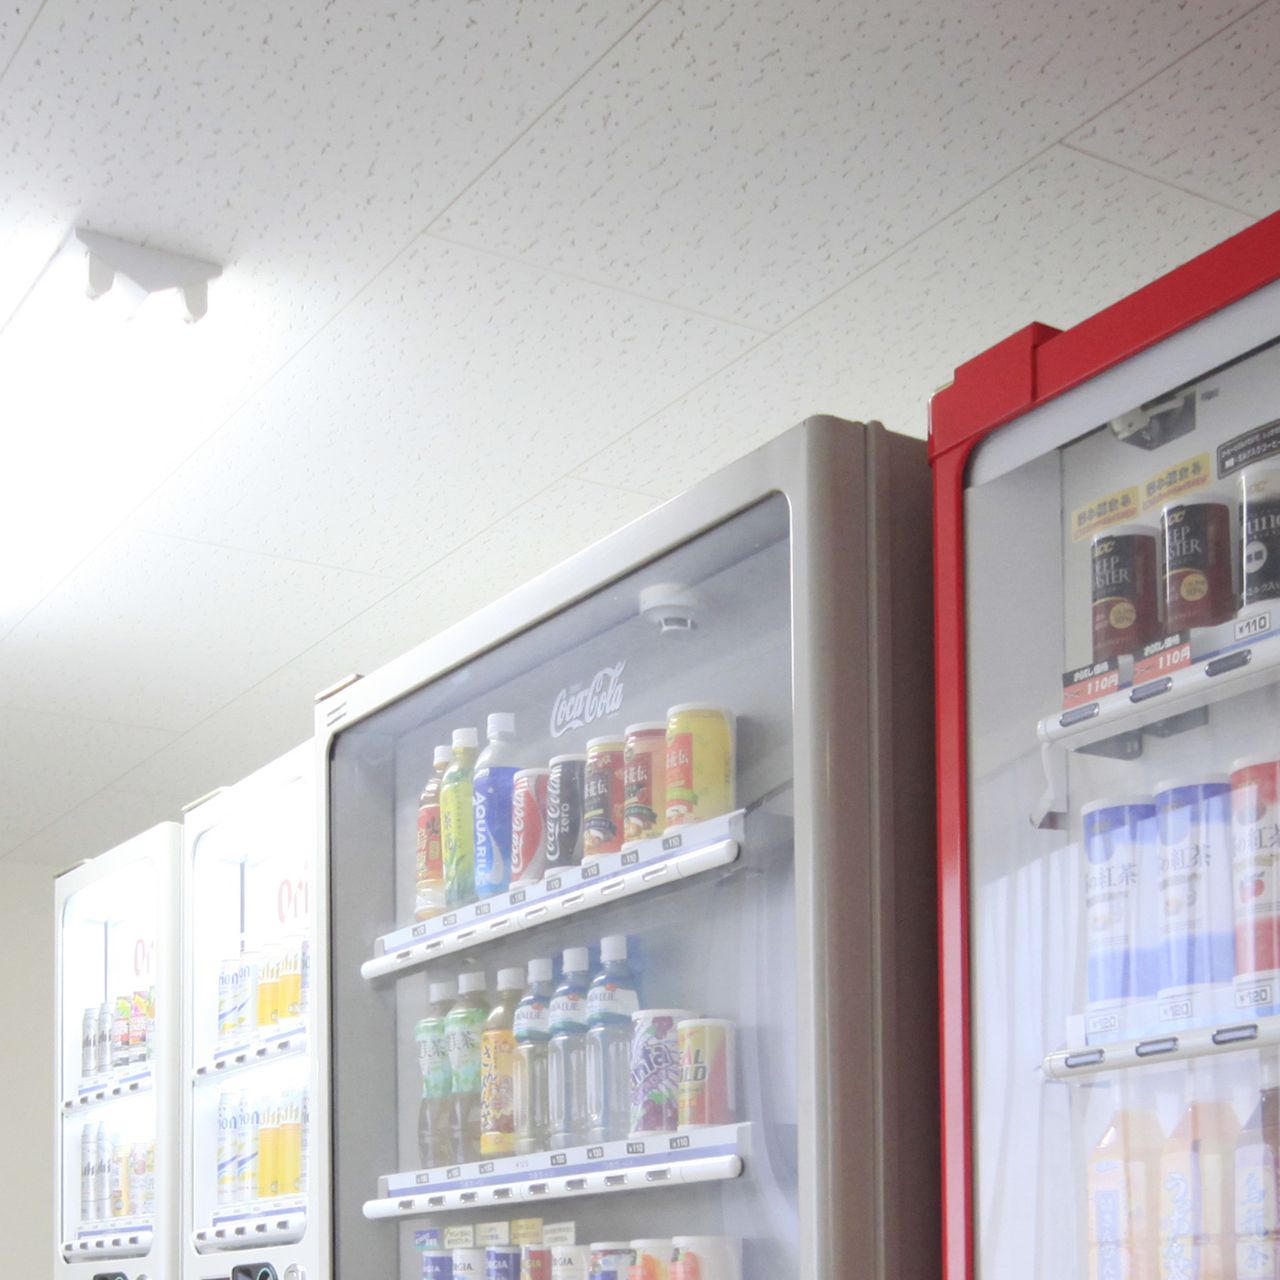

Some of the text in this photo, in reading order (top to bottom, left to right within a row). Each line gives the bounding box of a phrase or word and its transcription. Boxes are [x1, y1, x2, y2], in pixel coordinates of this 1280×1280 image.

[1237, 615, 1269, 636] ¥110
[1157, 645, 1191, 670] 110円
[1086, 674, 1119, 695] 110円
[560, 802, 570, 834] zero
[473, 791, 488, 888] AQUARIUS
